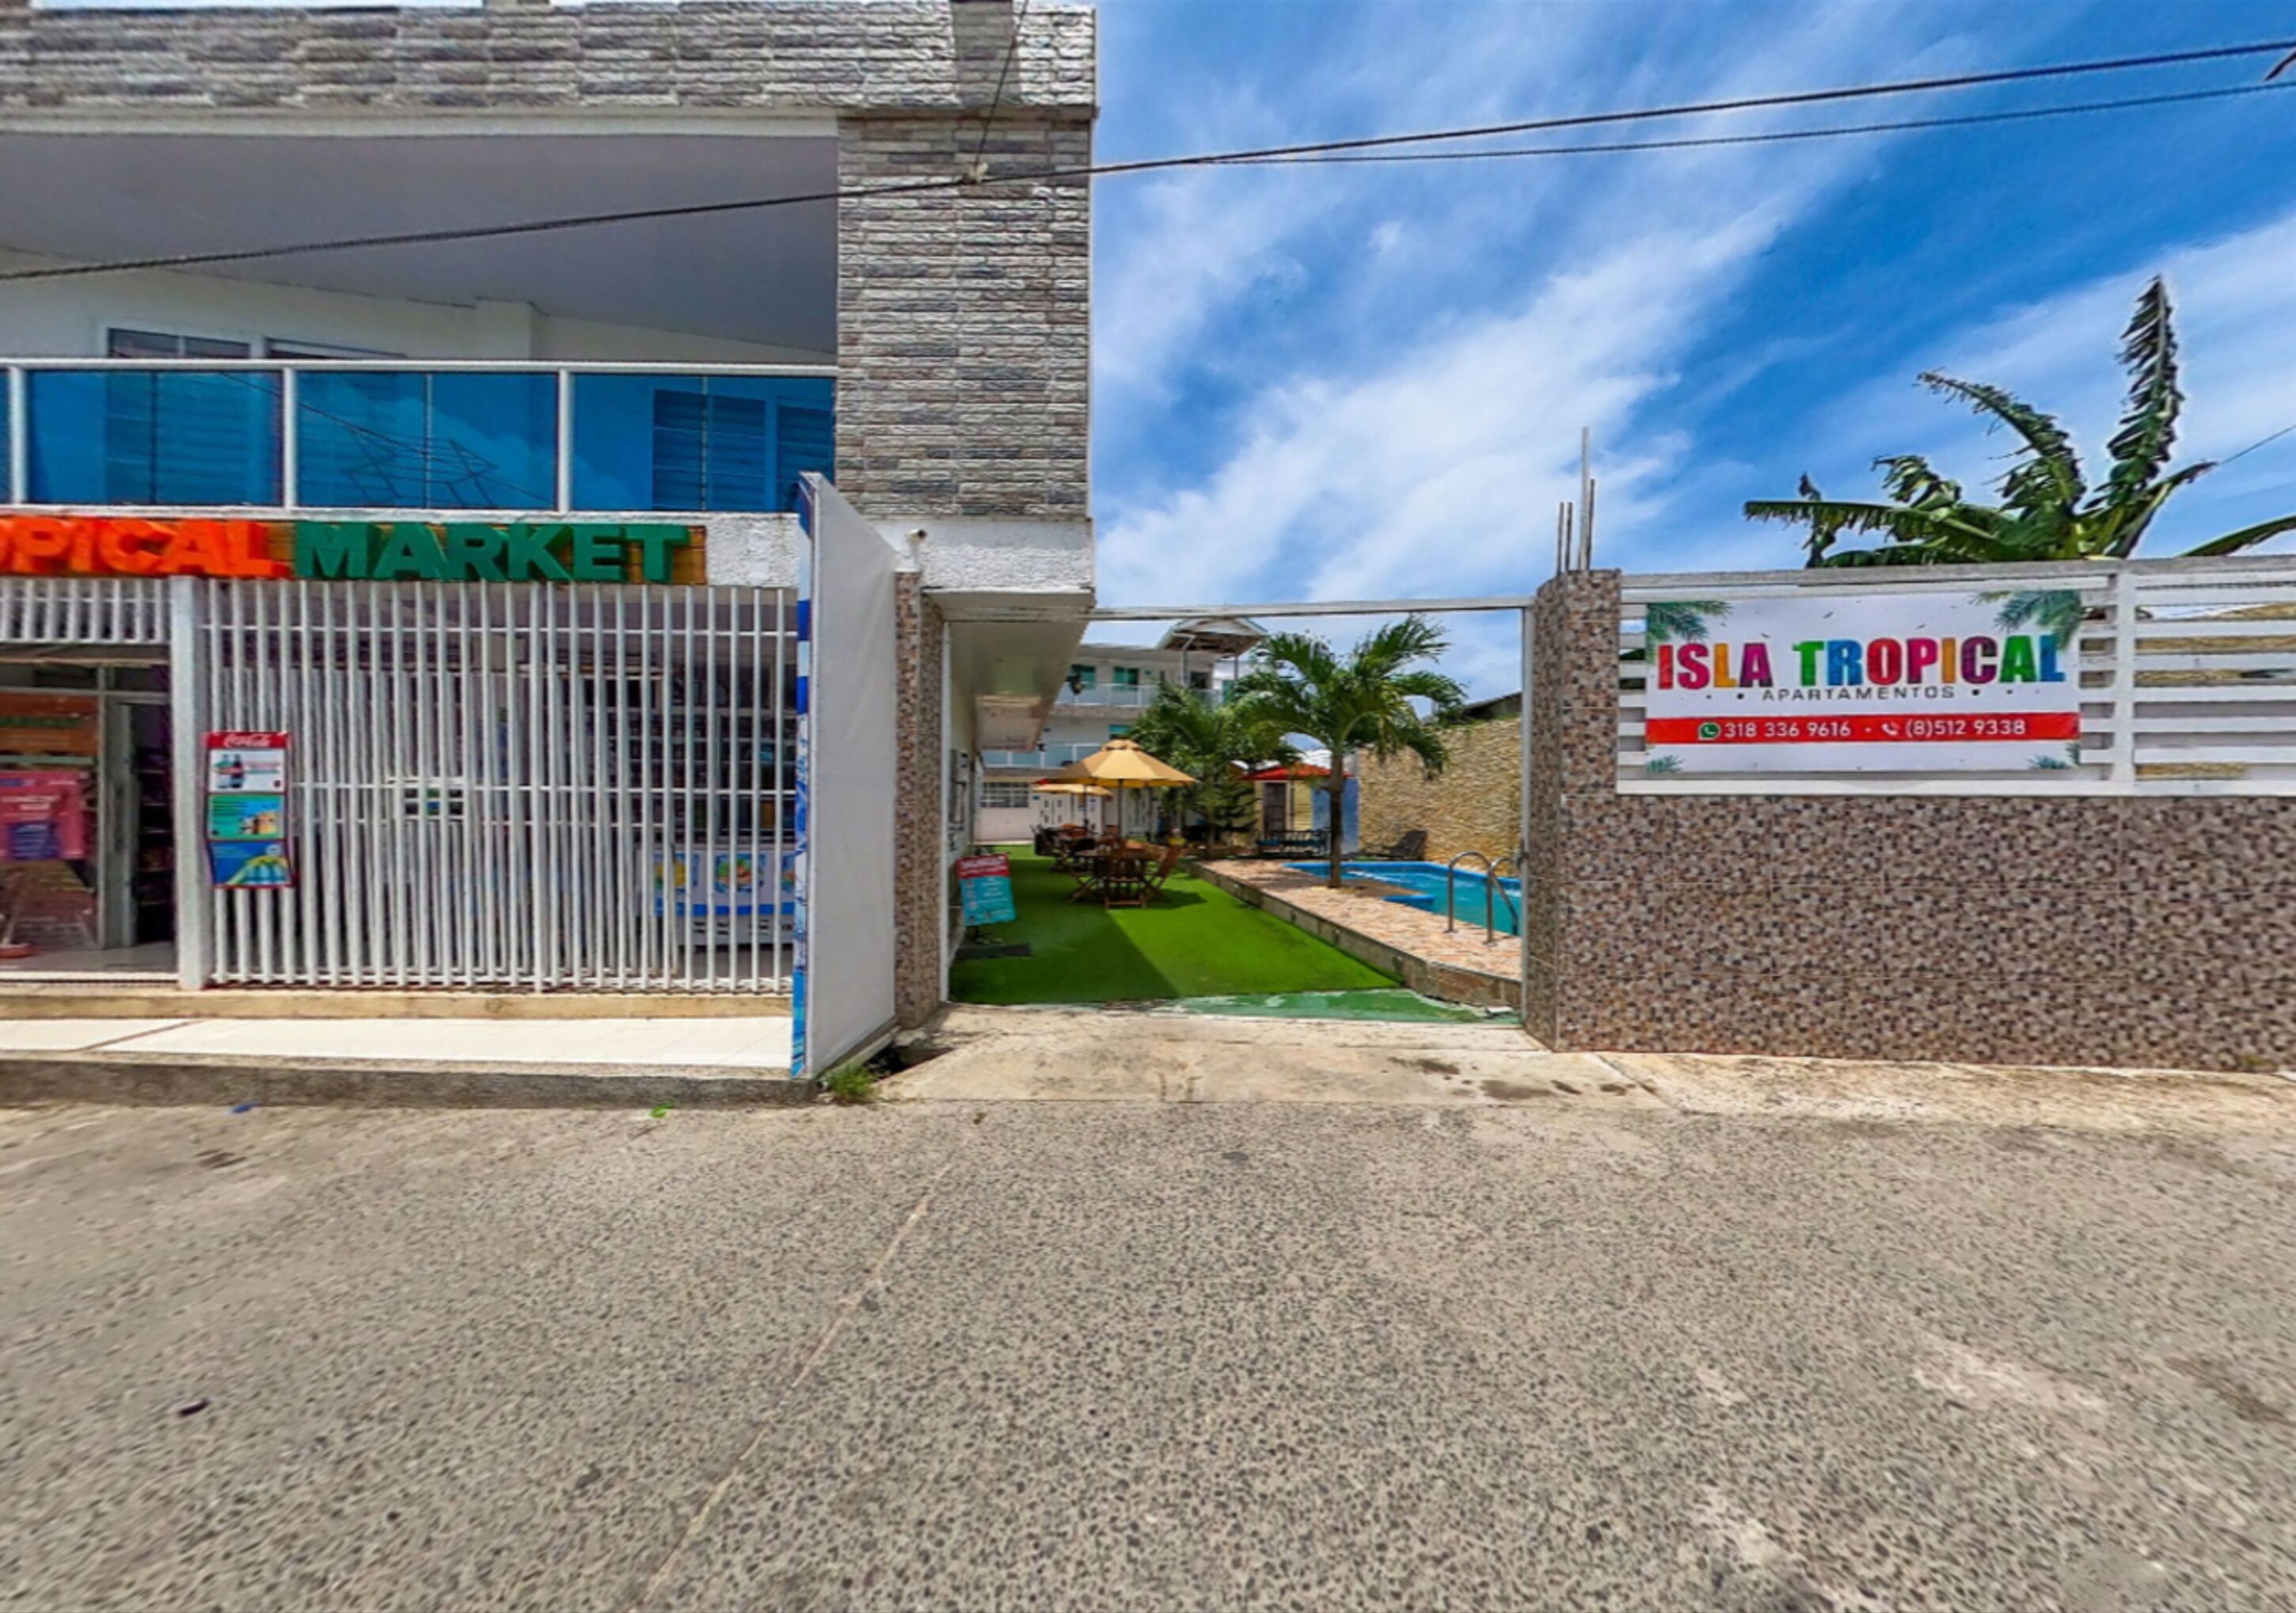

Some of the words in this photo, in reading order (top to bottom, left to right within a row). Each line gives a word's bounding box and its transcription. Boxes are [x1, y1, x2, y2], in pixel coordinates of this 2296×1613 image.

[0, 517, 279, 579] PICAL
[295, 521, 690, 581] MARKET
[1658, 642, 1773, 690] ISLA
[1792, 635, 2066, 687] TROPICAL
[1762, 686, 1955, 701] APARTAMENTOS
[1724, 722, 1758, 737] 318
[1764, 722, 1800, 737] 336
[1807, 721, 1851, 737] 9616
[1905, 718, 1966, 738] (8)512
[1974, 720, 2026, 735] 9338
